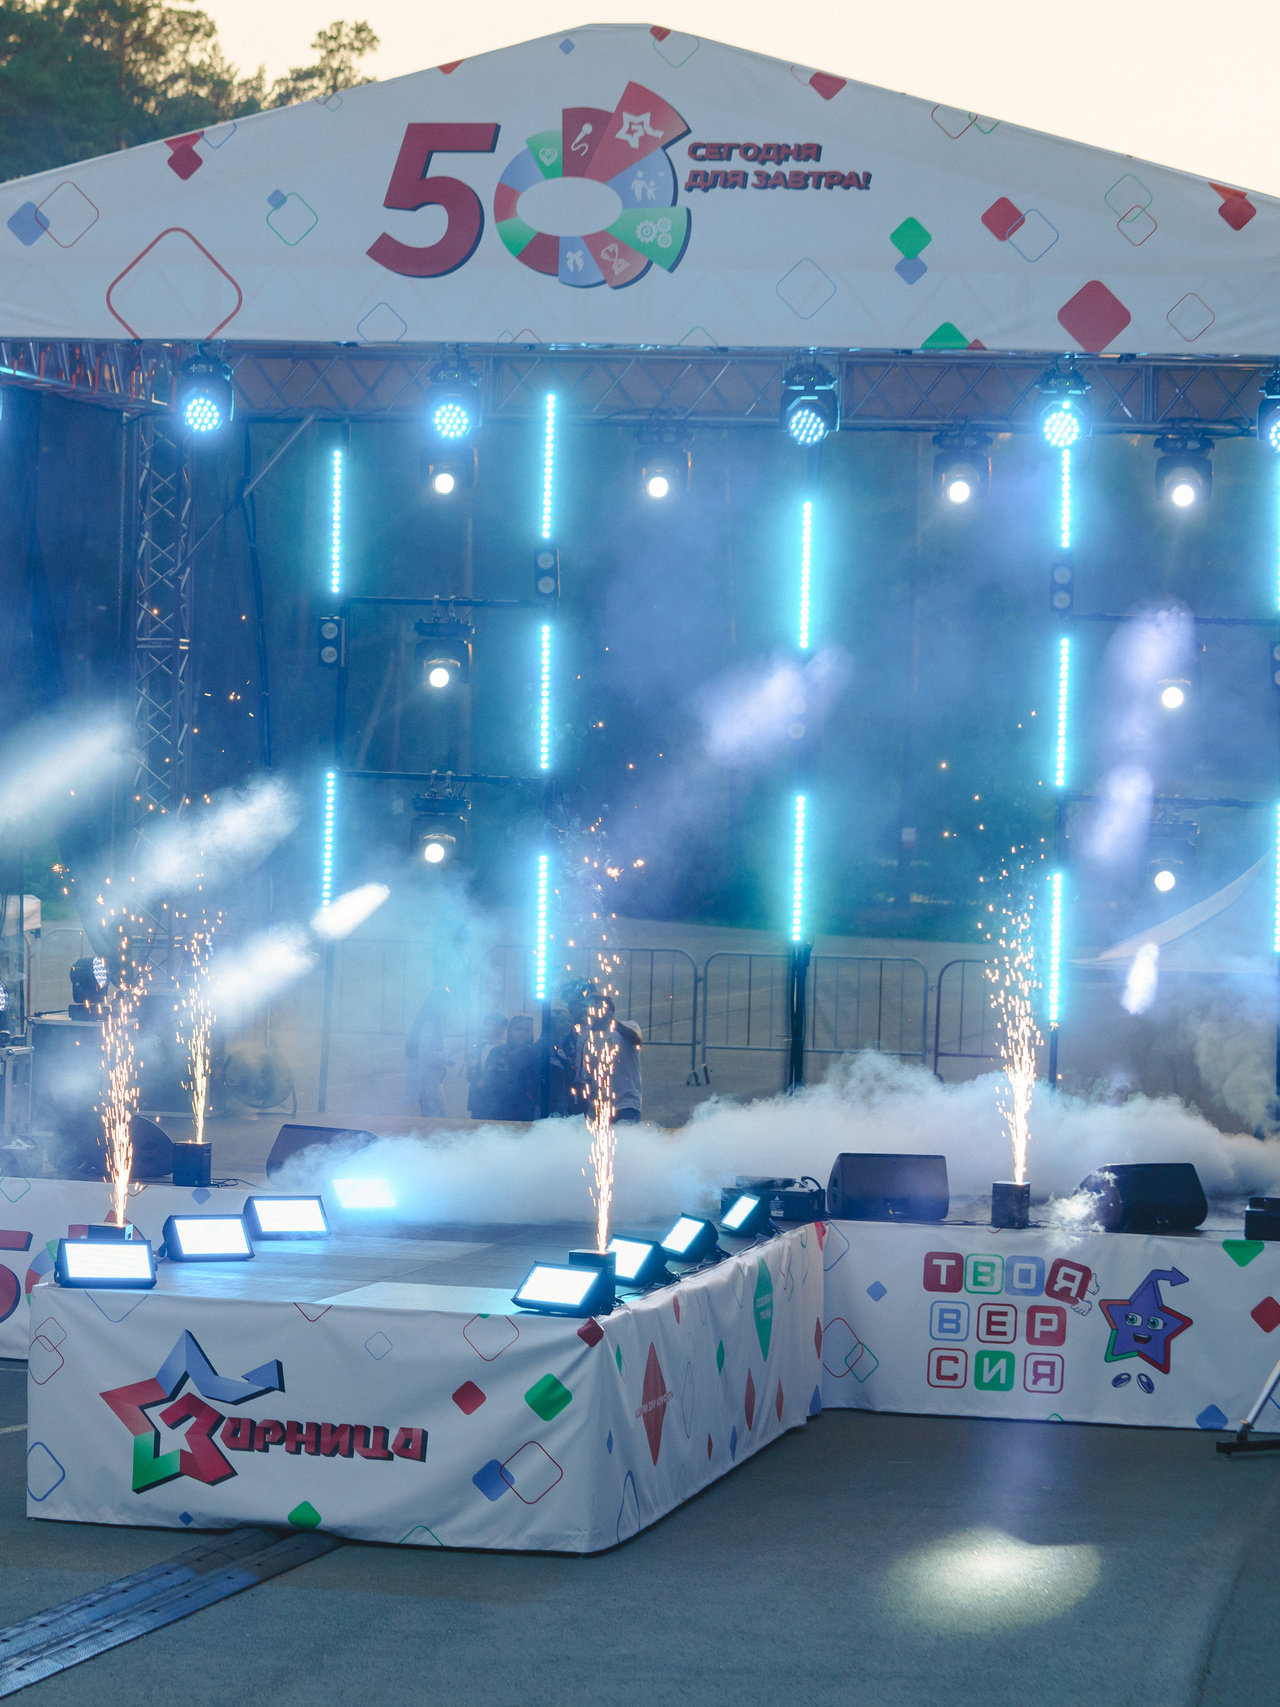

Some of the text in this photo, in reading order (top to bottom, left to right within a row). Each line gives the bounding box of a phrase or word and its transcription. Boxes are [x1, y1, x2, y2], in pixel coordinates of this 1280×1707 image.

[687, 142, 823, 166] СЕГОДНЯ
[366, 81, 692, 289] 50
[684, 170, 872, 192] ДЛЯ ЗАВТРА!
[927, 1256, 1085, 1301] ТВОЯ
[934, 1305, 1062, 1341] ВЕР
[932, 1352, 1060, 1389] СИЯ
